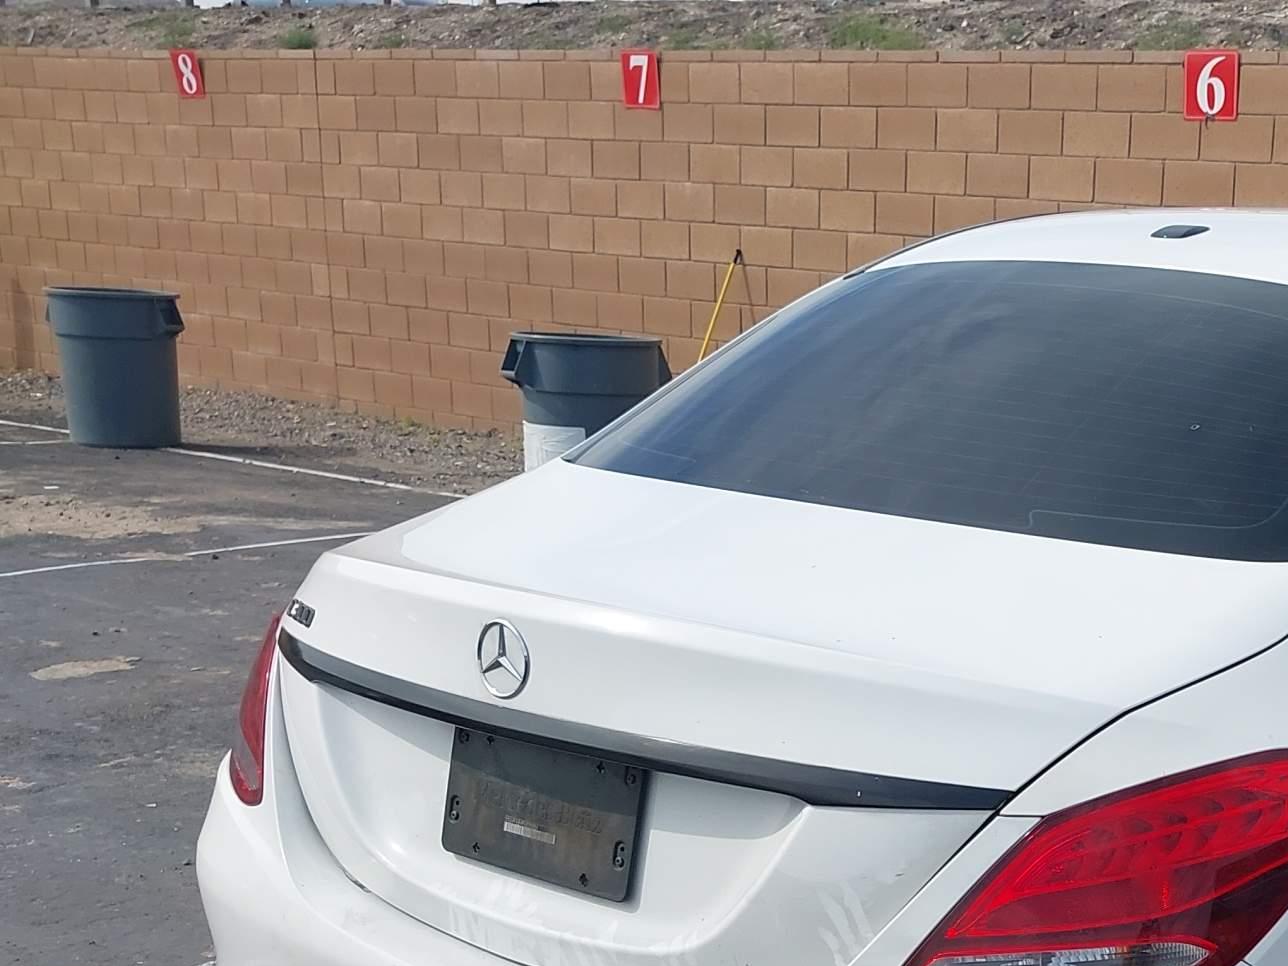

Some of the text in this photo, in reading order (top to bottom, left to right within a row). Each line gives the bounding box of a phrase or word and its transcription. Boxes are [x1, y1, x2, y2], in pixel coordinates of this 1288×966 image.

[177, 53, 198, 95] 8
[628, 54, 649, 104] 7
[1196, 53, 1225, 115] 6
